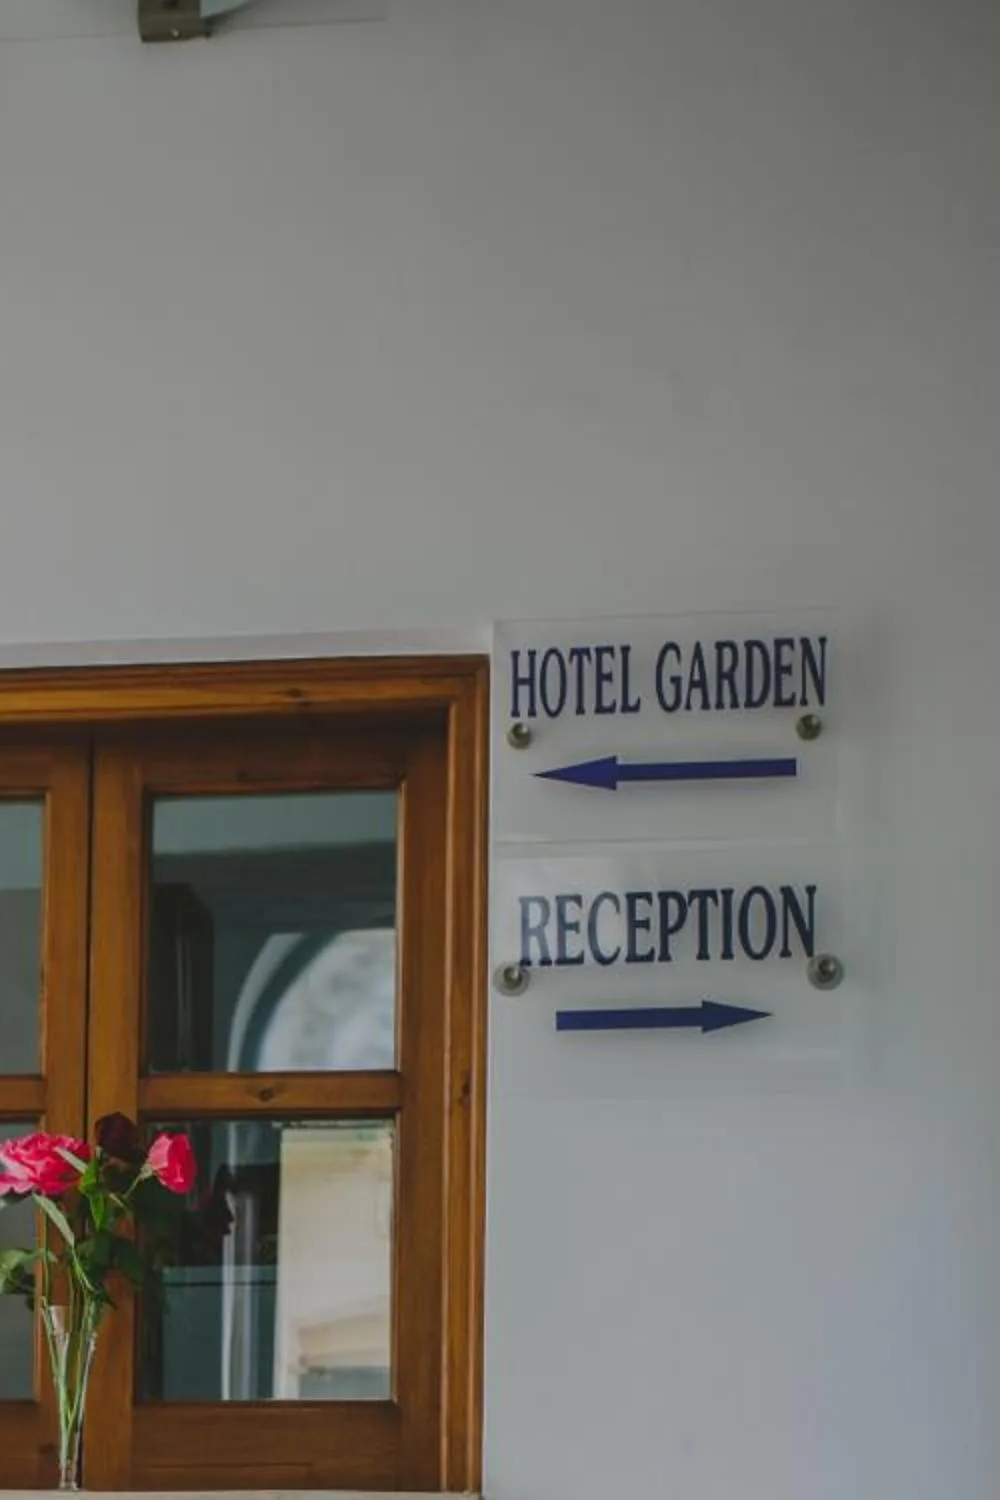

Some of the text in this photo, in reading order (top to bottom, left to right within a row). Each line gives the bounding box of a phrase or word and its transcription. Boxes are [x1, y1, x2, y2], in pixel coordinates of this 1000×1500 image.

[510, 636, 828, 718] HOTEL GARDEN
[518, 885, 817, 967] RECEPTION
